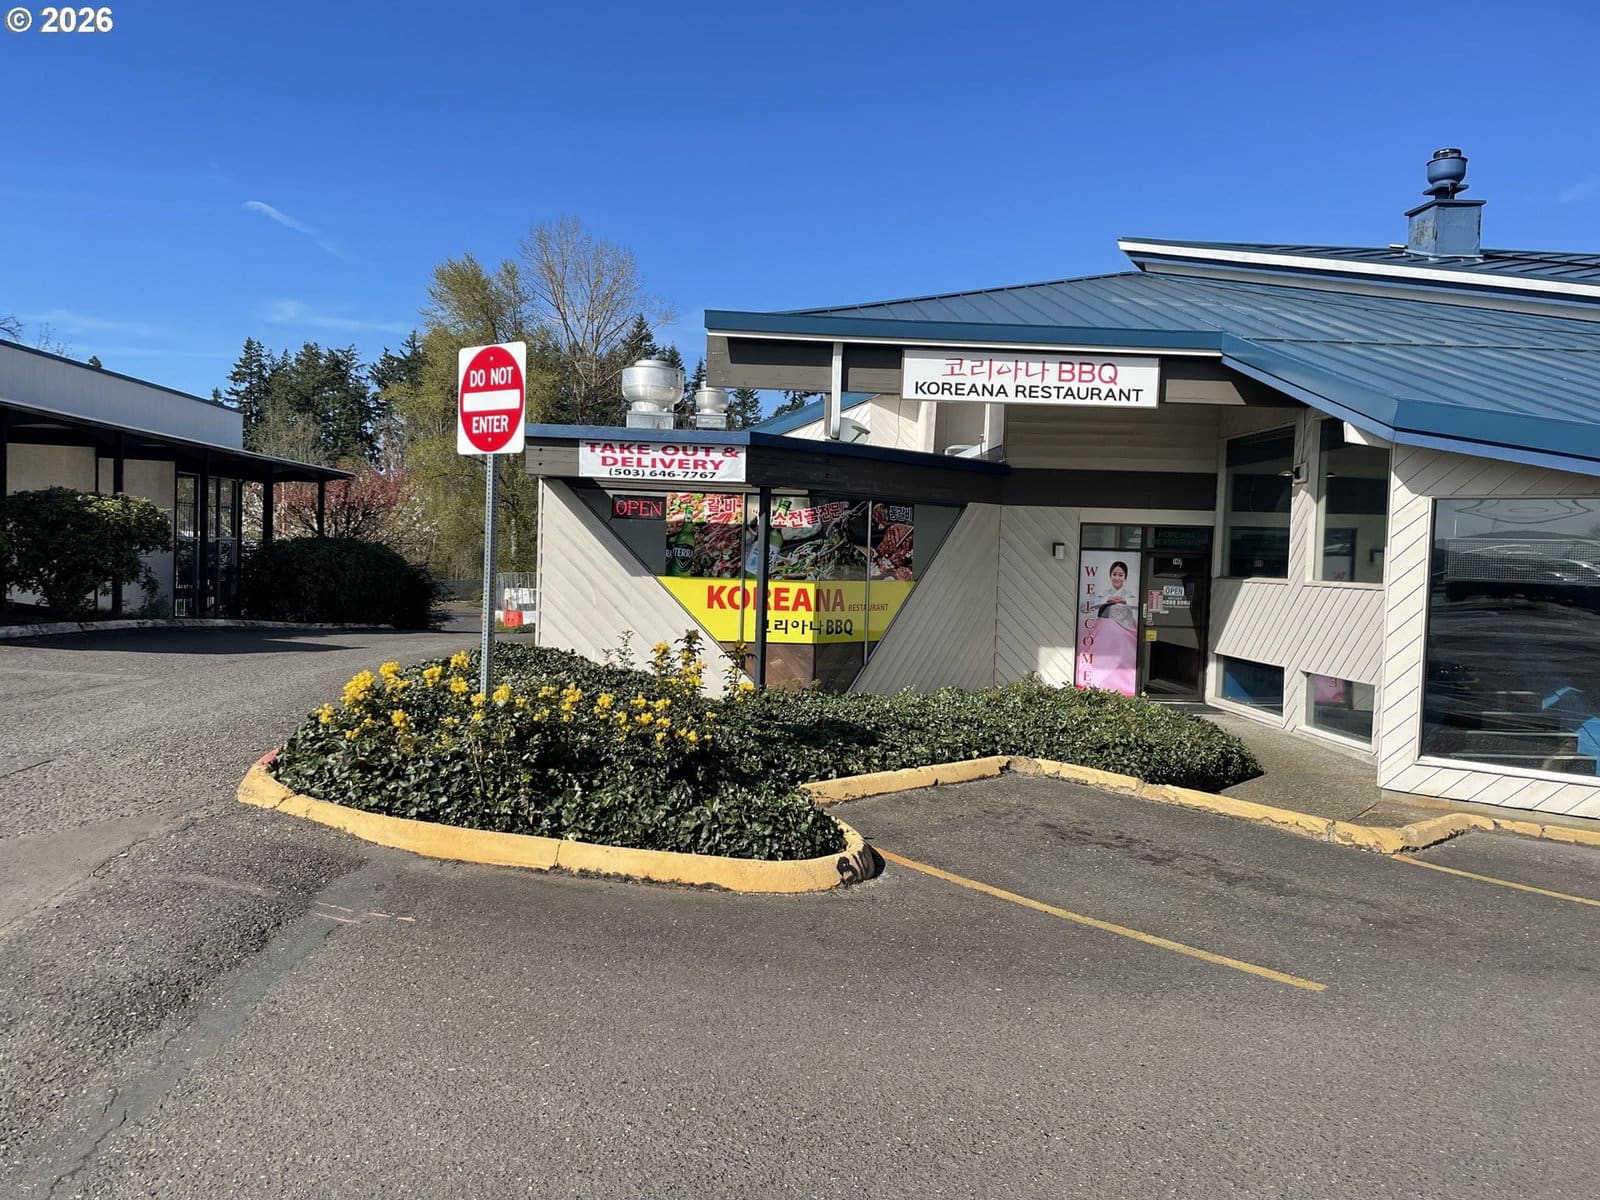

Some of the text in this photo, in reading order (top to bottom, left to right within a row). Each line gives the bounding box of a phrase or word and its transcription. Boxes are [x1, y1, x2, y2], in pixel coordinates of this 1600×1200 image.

[469, 366, 514, 388] DO NOT
[942, 357, 1118, 386] 코리아나 BBQ
[914, 380, 1144, 402] KOREANA RESTAURANT
[472, 415, 509, 434] ENTER
[585, 442, 740, 458] TAKE-OUT &
[601, 456, 724, 471] DELIVERY
[609, 467, 717, 479] (503) 646-7767
[615, 499, 663, 517] OPEN
[707, 498, 736, 513] 갈비
[826, 619, 852, 636] BBQ
[1082, 565, 1099, 681] WELCOME
